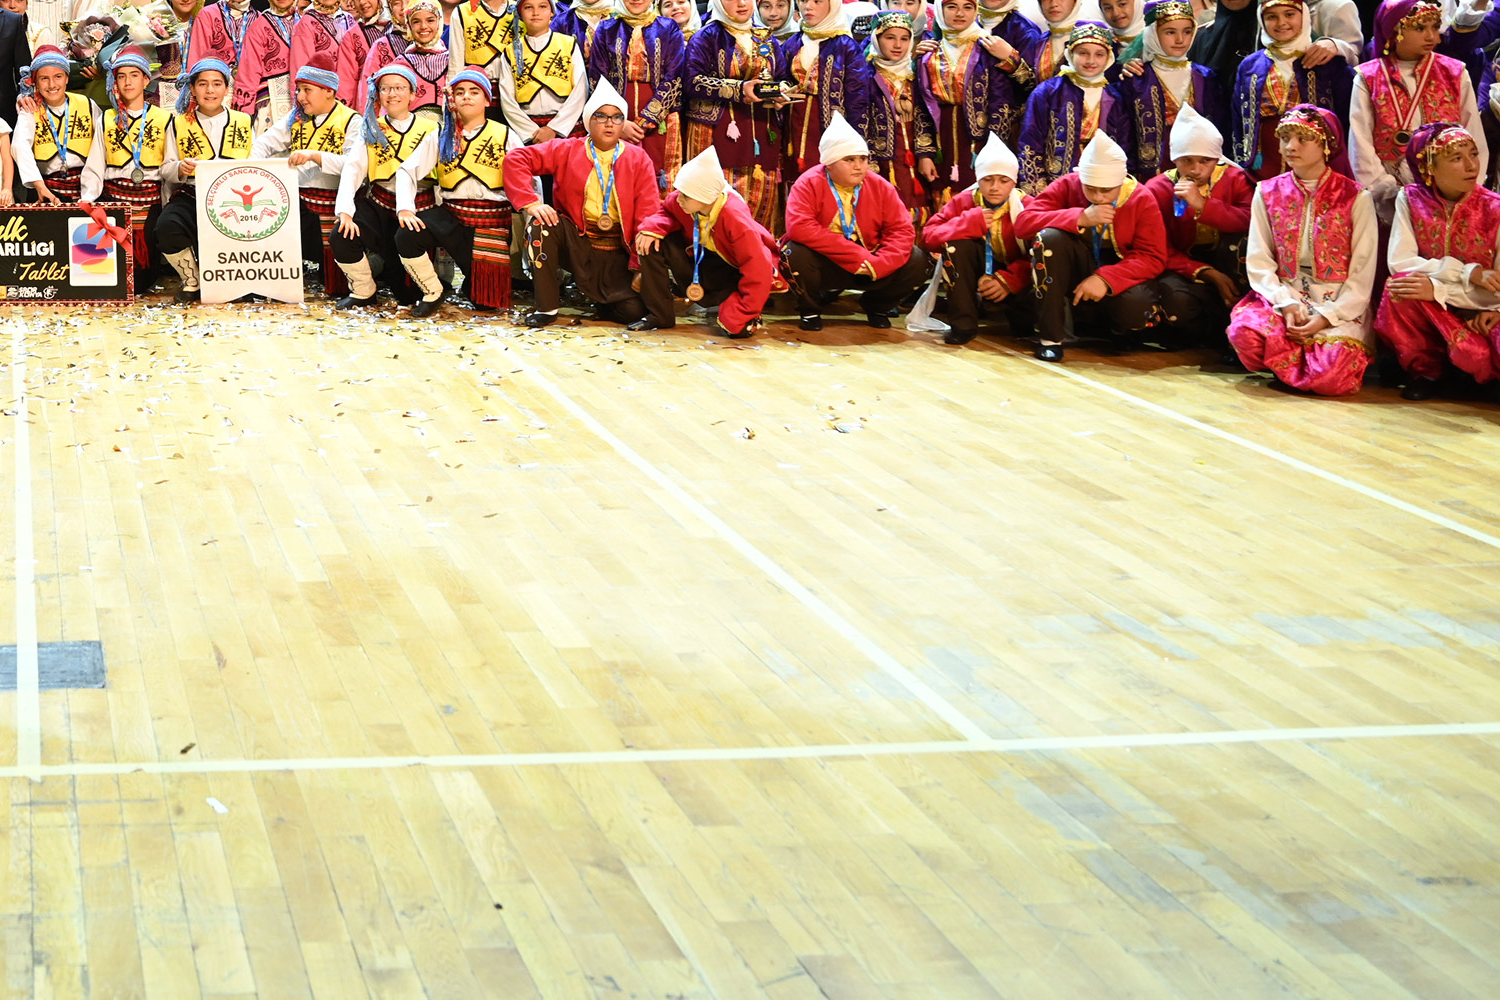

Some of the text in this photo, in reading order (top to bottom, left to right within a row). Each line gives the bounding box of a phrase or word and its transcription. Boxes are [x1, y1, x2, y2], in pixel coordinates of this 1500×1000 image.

[228, 168, 259, 178] SANCAK
[259, 171, 288, 204] ORTAOKULU
[217, 251, 283, 264] SANCAK
[19, 262, 69, 280] Tablet
[203, 267, 300, 281] ORTAOKULU
